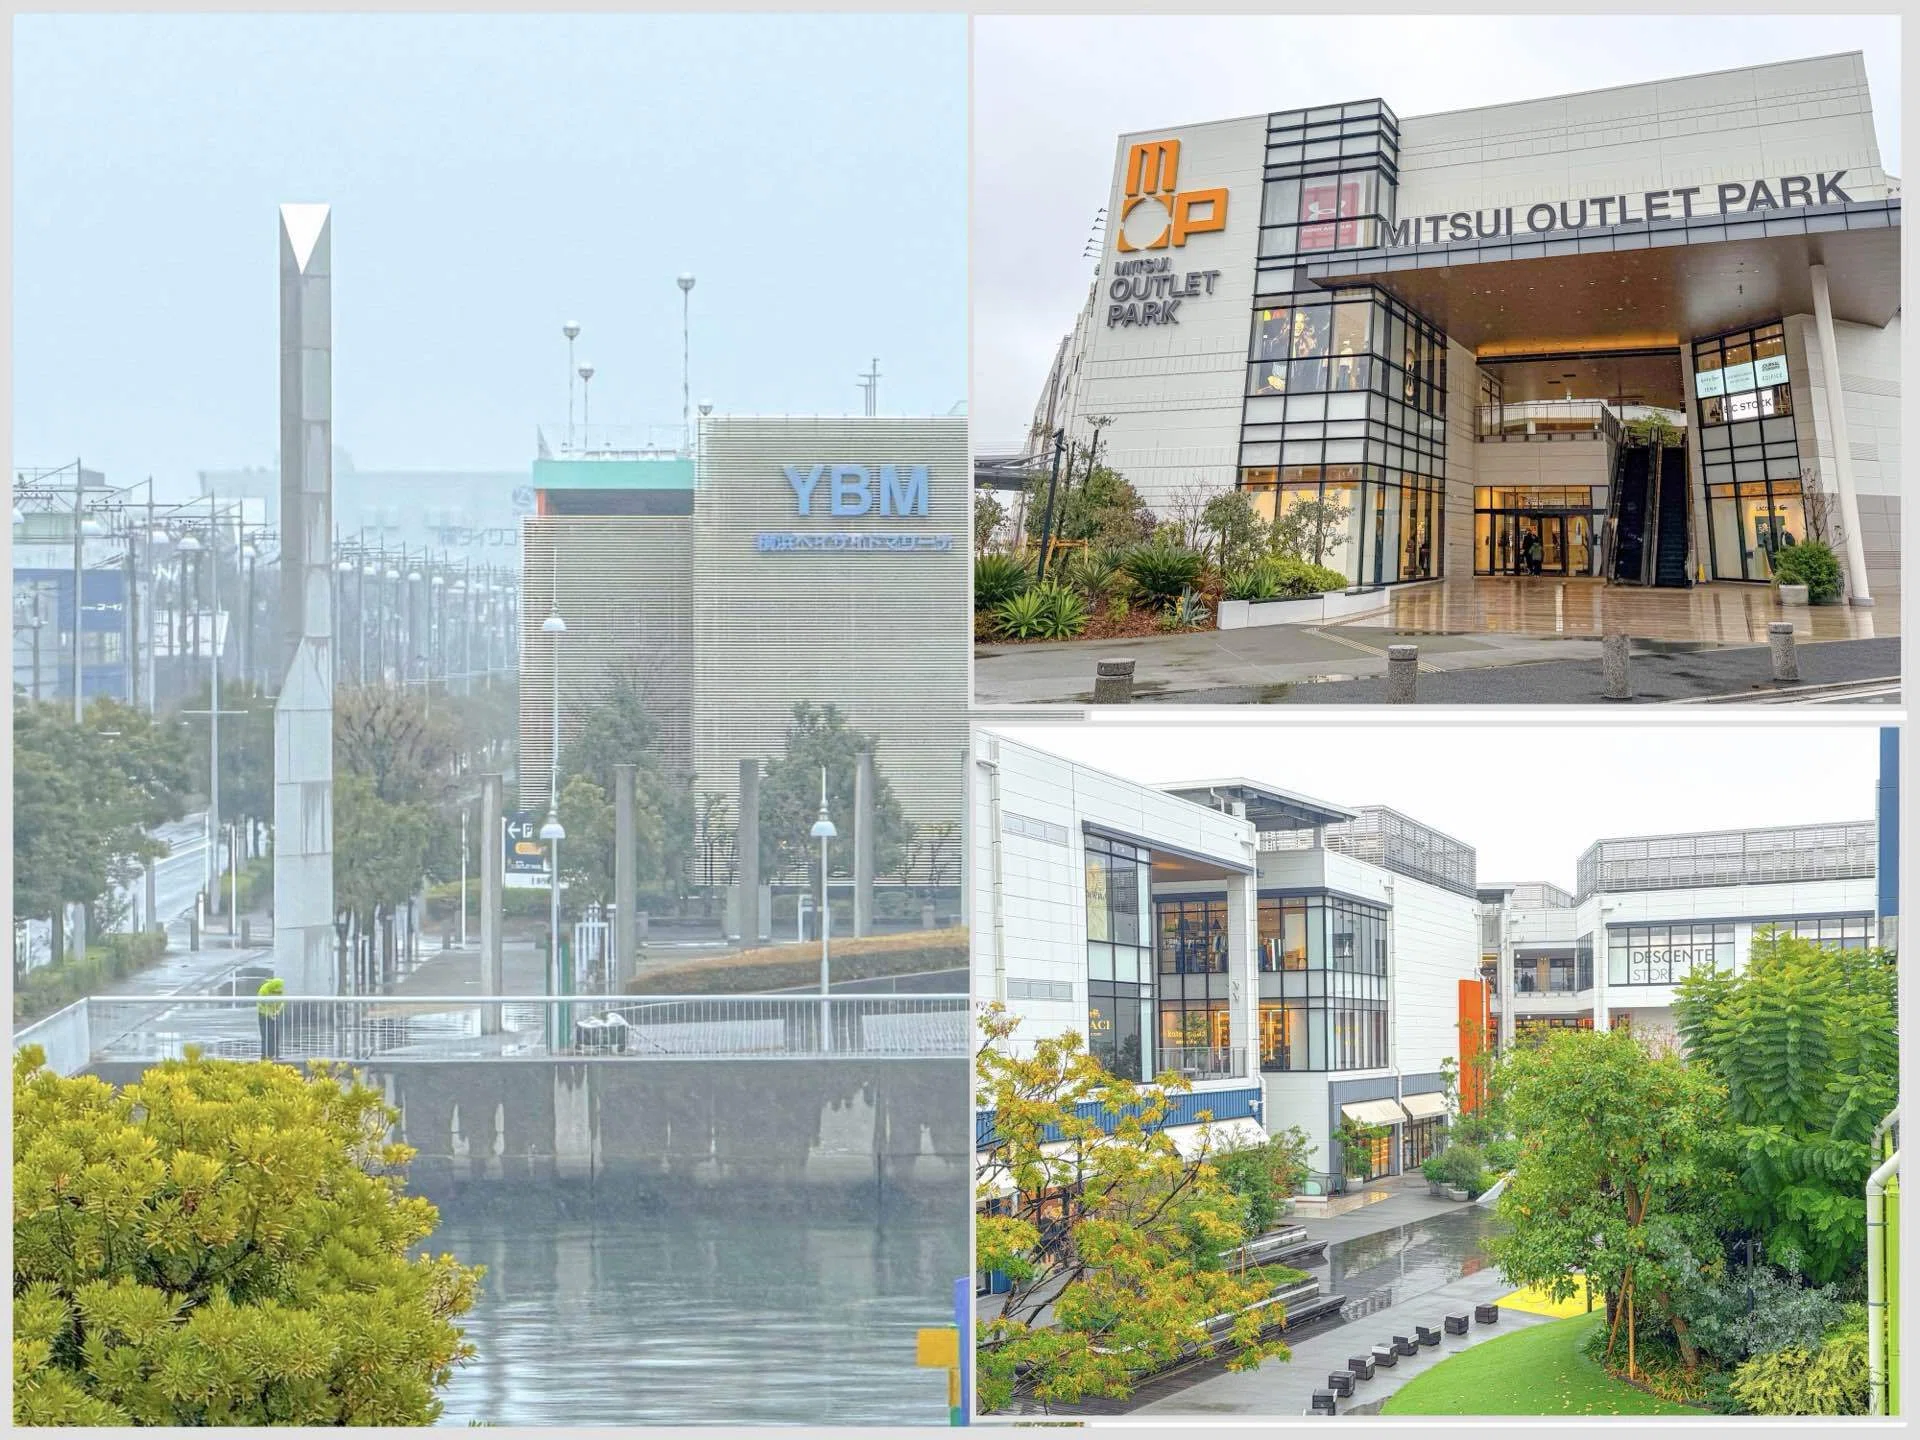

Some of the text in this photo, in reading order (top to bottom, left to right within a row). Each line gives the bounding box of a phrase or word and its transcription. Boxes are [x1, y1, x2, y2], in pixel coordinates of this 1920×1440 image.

[1380, 170, 1853, 248] MITSUI OUTLET PARK
[1114, 257, 1171, 276] MITSUI
[1109, 270, 1220, 302] OUTLET
[1107, 300, 1181, 328] PARK
[1740, 398, 1772, 412] STOCK
[783, 464, 929, 517] YBM
[1633, 948, 1714, 965] DESCENTE
[1633, 967, 1675, 981] STORE
